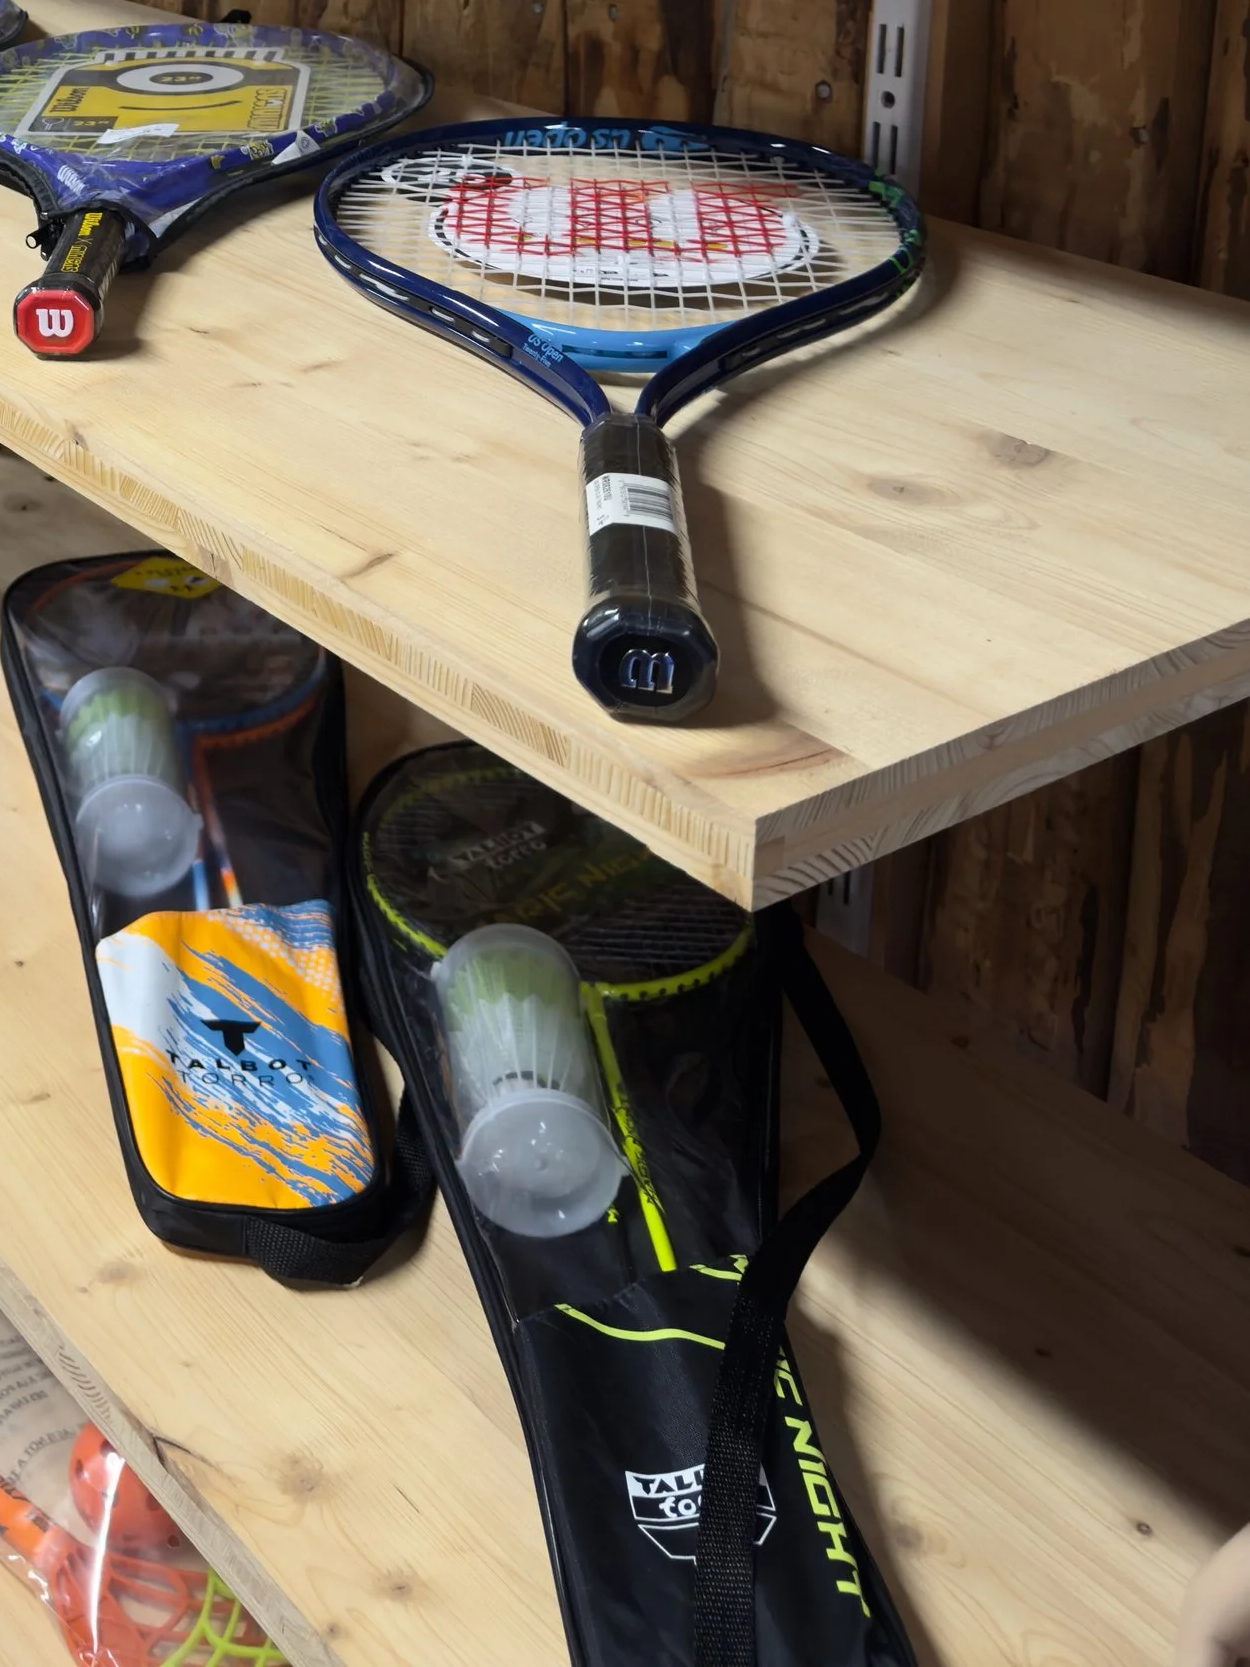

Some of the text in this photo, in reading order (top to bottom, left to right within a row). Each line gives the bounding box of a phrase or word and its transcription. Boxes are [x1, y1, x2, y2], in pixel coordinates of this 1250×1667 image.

[49, 86, 90, 114] Wilson
[504, 121, 632, 150] us open
[78, 212, 103, 236] Wilson
[36, 308, 74, 338] W
[527, 334, 564, 362] US Open
[166, 1048, 312, 1072] TALBOT
[177, 1070, 303, 1087] TORRO
[785, 1416, 871, 1619] NIGHT
